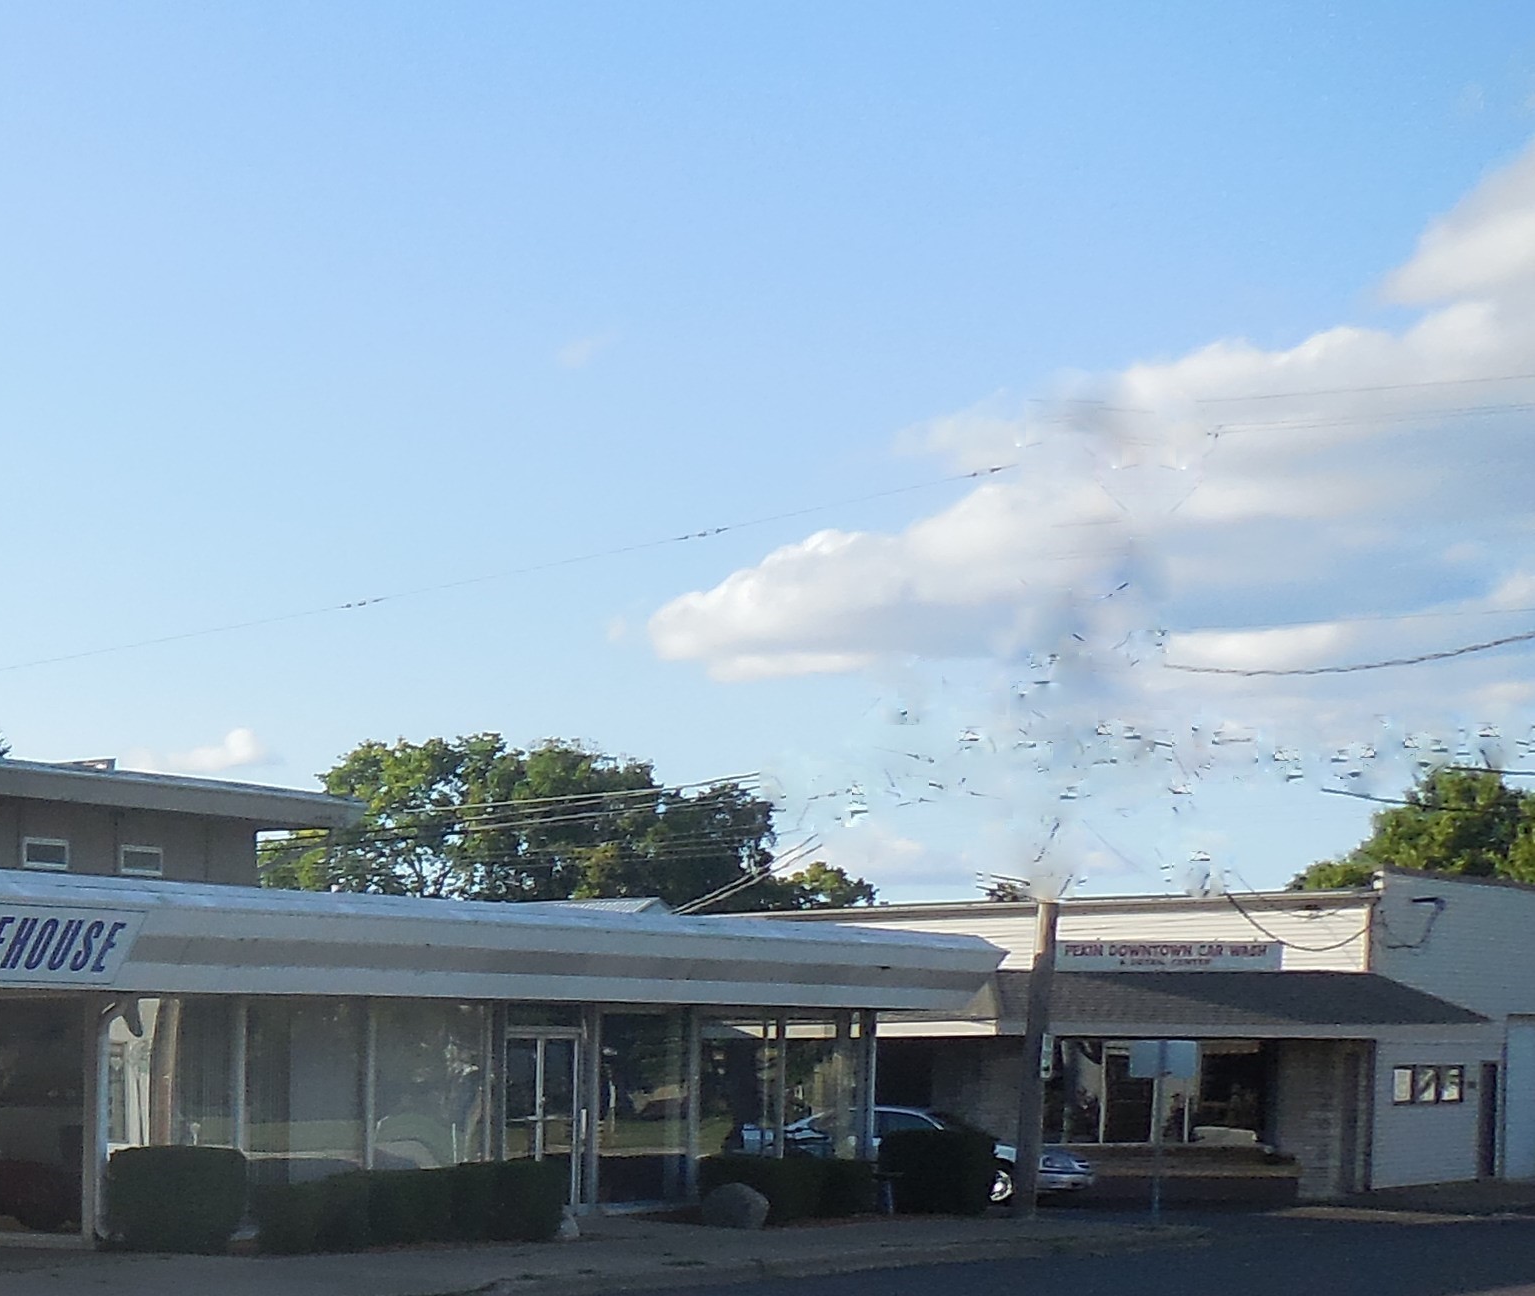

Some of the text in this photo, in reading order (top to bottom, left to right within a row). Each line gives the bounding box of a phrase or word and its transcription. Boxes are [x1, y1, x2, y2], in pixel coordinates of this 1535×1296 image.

[1108, 944, 1193, 957] DOWNTOWN
[1198, 944, 1224, 956] CAR
[1230, 944, 1268, 957] WASH
